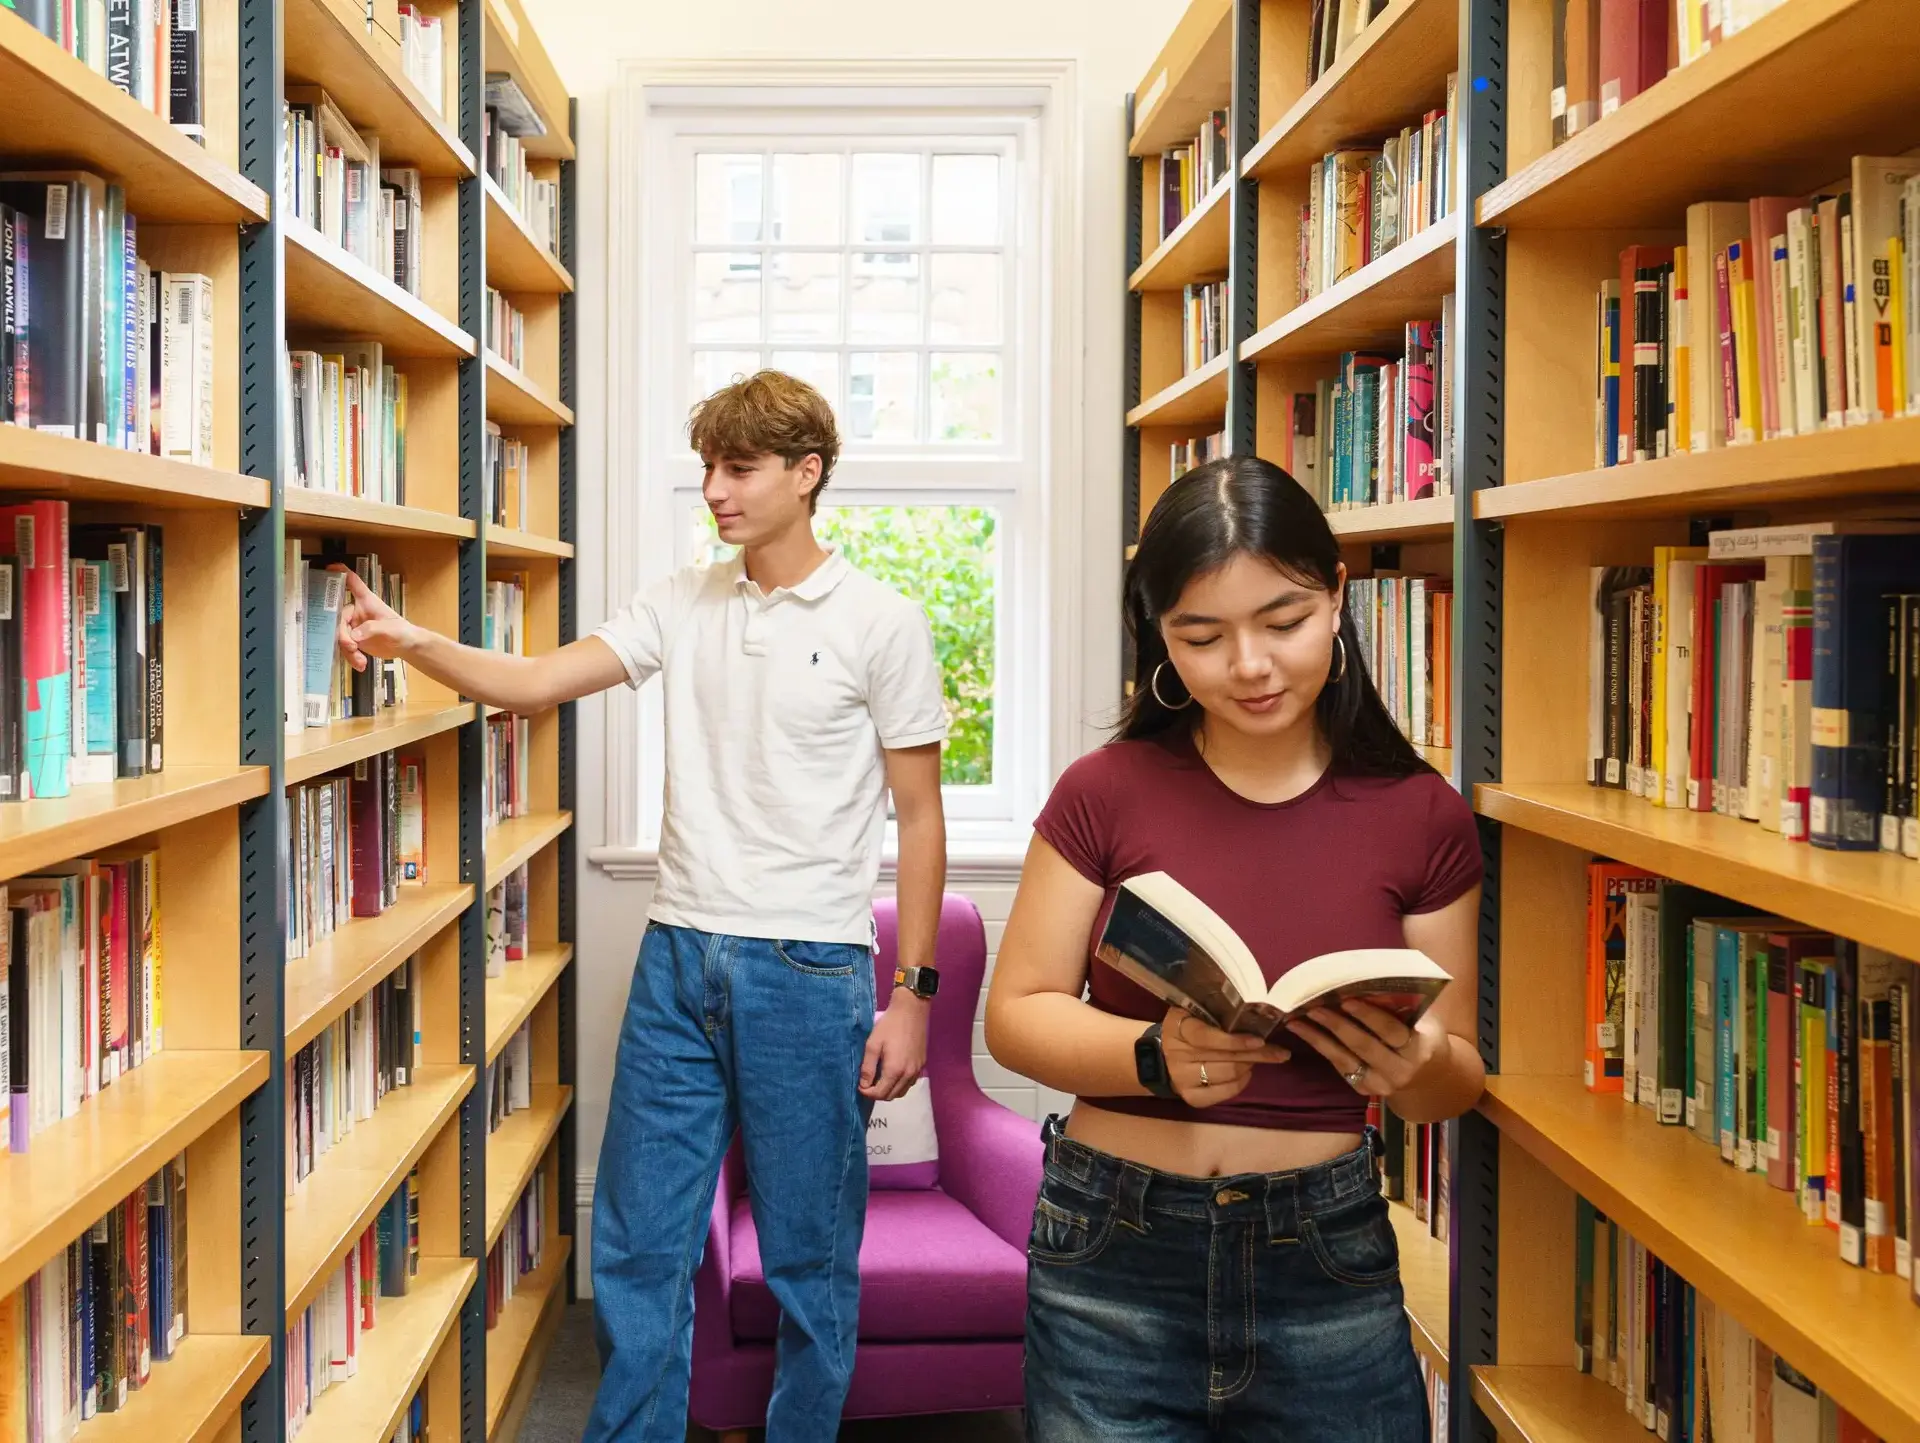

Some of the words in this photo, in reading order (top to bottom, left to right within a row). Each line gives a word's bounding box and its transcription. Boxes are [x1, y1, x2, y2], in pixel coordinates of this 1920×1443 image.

[1373, 160, 1383, 222] CANCER
[4, 222, 14, 261] JOHN
[125, 229, 137, 264] WHEN
[1372, 225, 1382, 262] WAR
[125, 270, 137, 287] WE
[5, 265, 15, 334] BANVILLE
[125, 292, 137, 324] WERE
[125, 331, 137, 368] BIRDS
[149, 658, 157, 738] blackman
[1607, 878, 1656, 895] PETER
[0, 994, 8, 1011] JOE
[0, 1015, 8, 1046] DAVID
[105, 1002, 113, 1048] SECTION
[868, 1117, 888, 1129] WN
[866, 1145, 893, 1155] OOLF
[139, 1230, 148, 1310] STORIES
